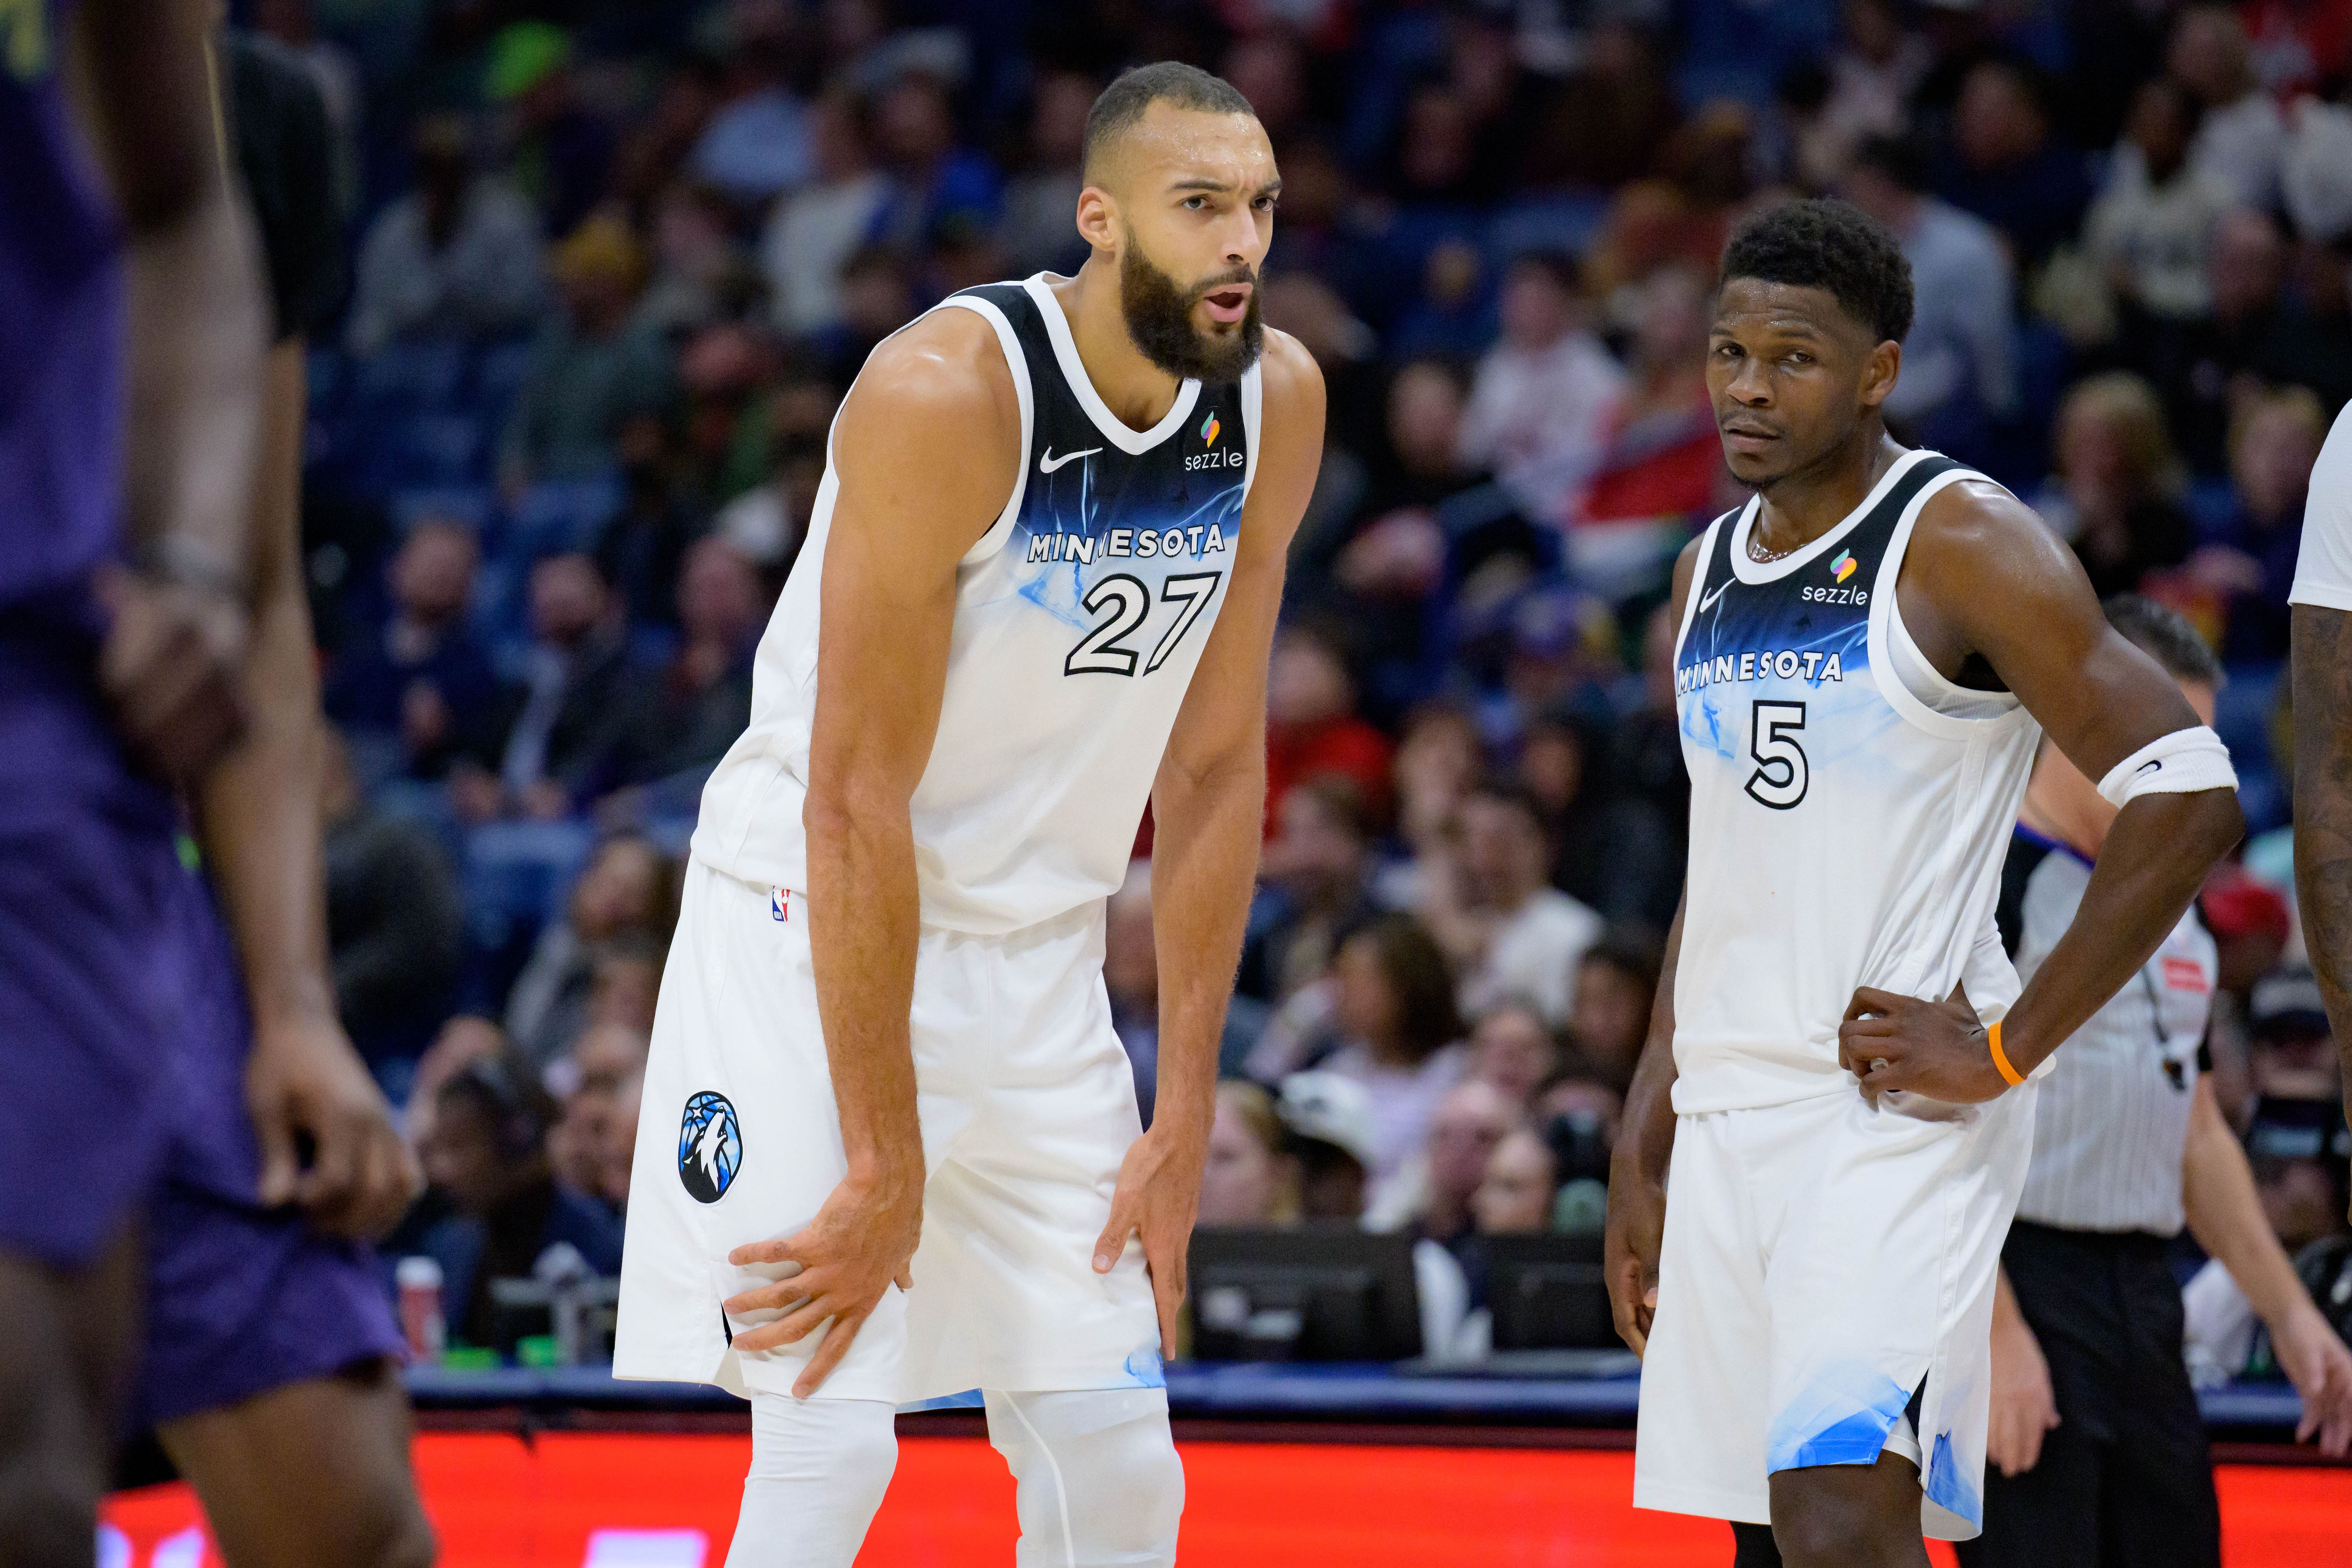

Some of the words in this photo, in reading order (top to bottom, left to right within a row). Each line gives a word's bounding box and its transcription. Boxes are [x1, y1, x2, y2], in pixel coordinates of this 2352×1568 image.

[1185, 447, 1243, 471] sezzle
[1802, 585, 1868, 605] sezzle
[1064, 571, 1223, 677] 27
[1677, 650, 1843, 697] MINNESOTA
[1744, 699, 1809, 810] 5
[774, 911, 782, 919] NBA
